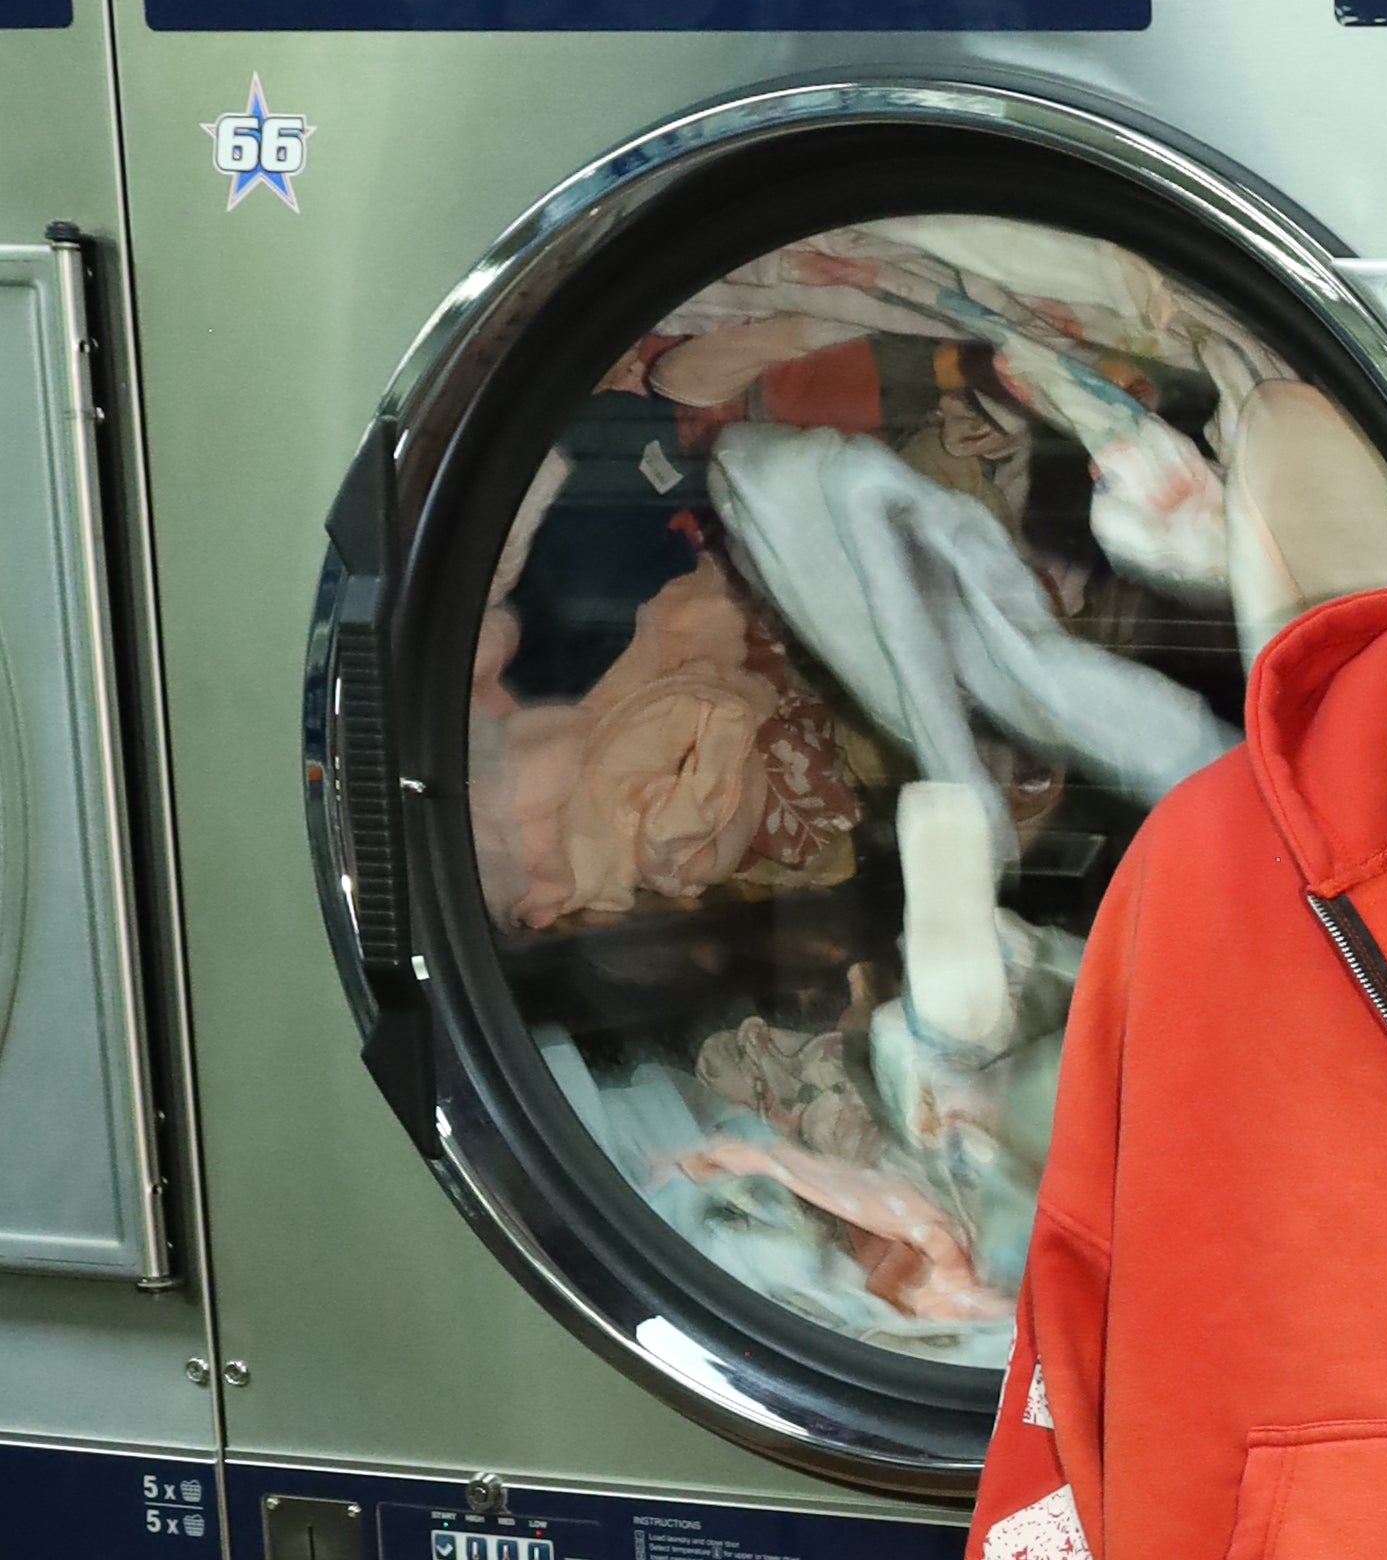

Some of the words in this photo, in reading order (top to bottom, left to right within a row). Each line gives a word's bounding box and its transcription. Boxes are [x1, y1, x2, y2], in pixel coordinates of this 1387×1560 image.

[212, 114, 308, 173] 66
[143, 1474, 159, 1499] 5
[145, 1509, 162, 1533] 5
